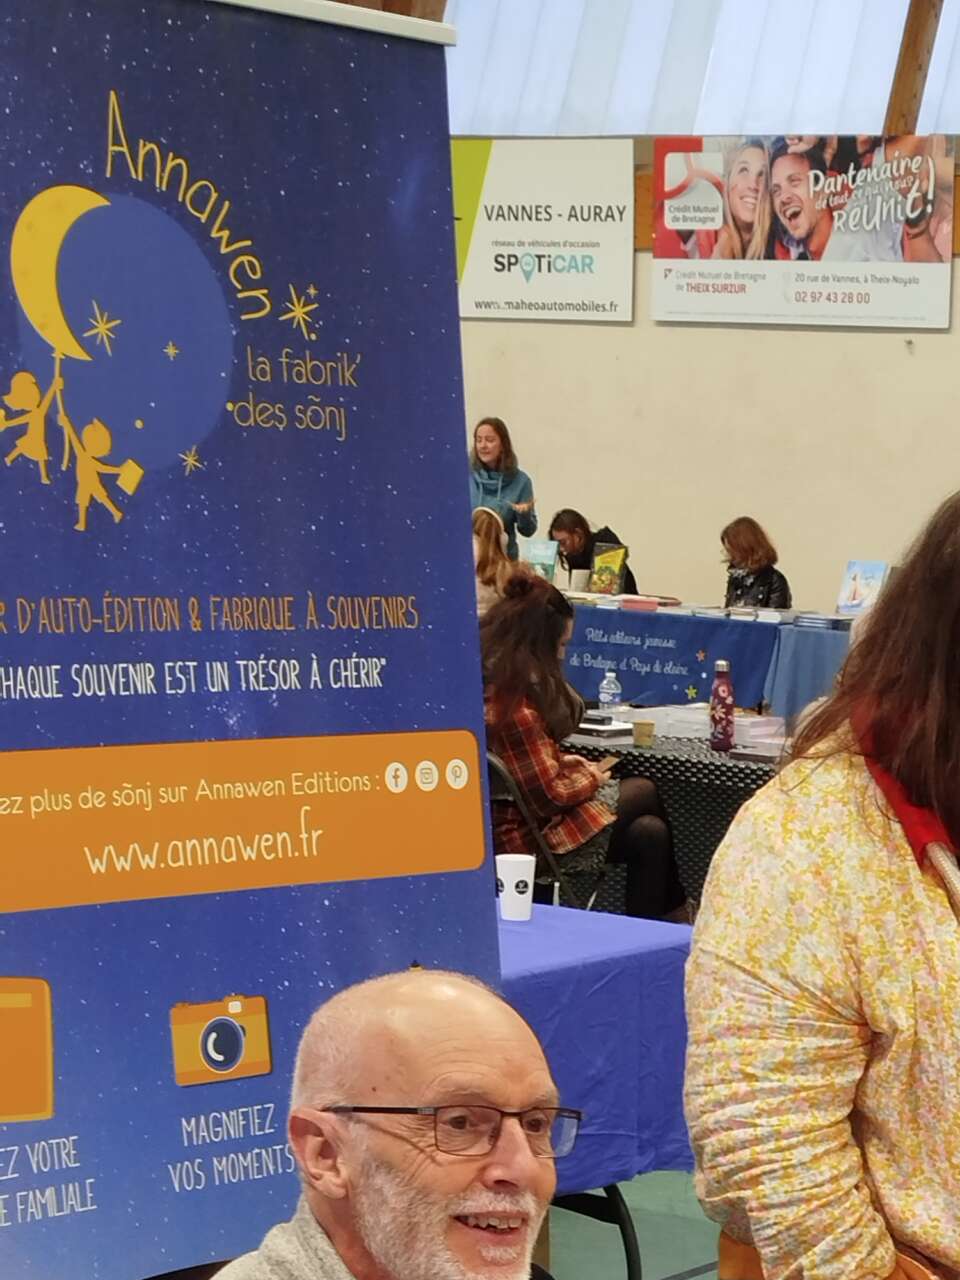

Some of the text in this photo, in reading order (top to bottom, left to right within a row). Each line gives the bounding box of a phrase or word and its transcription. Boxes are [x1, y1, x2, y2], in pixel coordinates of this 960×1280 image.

[808, 151, 922, 198] Partenaire
[106, 90, 272, 321] Annawen
[484, 204, 627, 222] VANNES AURAY
[693, 205, 719, 214] Mutuel
[686, 283, 709, 293] THEIX
[795, 291, 807, 303] 02
[856, 292, 870, 304] 00
[247, 345, 271, 383] la
[233, 395, 347, 441] des sõnj
[16, 590, 419, 634] D'AUTO-ÉDITION & FABRIQUE À SOUVENIRS
[0, 664, 63, 700] HAQUE
[71, 661, 157, 698] SOUVENIR
[164, 660, 197, 695] EST
[205, 659, 229, 692] UN
[236, 653, 301, 692] TRÉSOR
[309, 653, 322, 690] À
[30, 788, 73, 819] plus
[78, 785, 106, 809] de
[112, 781, 152, 811] sõnj
[159, 784, 187, 804] sur
[196, 777, 285, 802] Annawen
[293, 770, 371, 796] Editions
[84, 806, 323, 875] www.annawen.fr
[181, 1103, 275, 1148] MAGNIFIEZ
[25, 1135, 80, 1174] VOTRE
[168, 1146, 295, 1193] VOS MOMENTS
[16, 1178, 98, 1223] FAMILIALE
